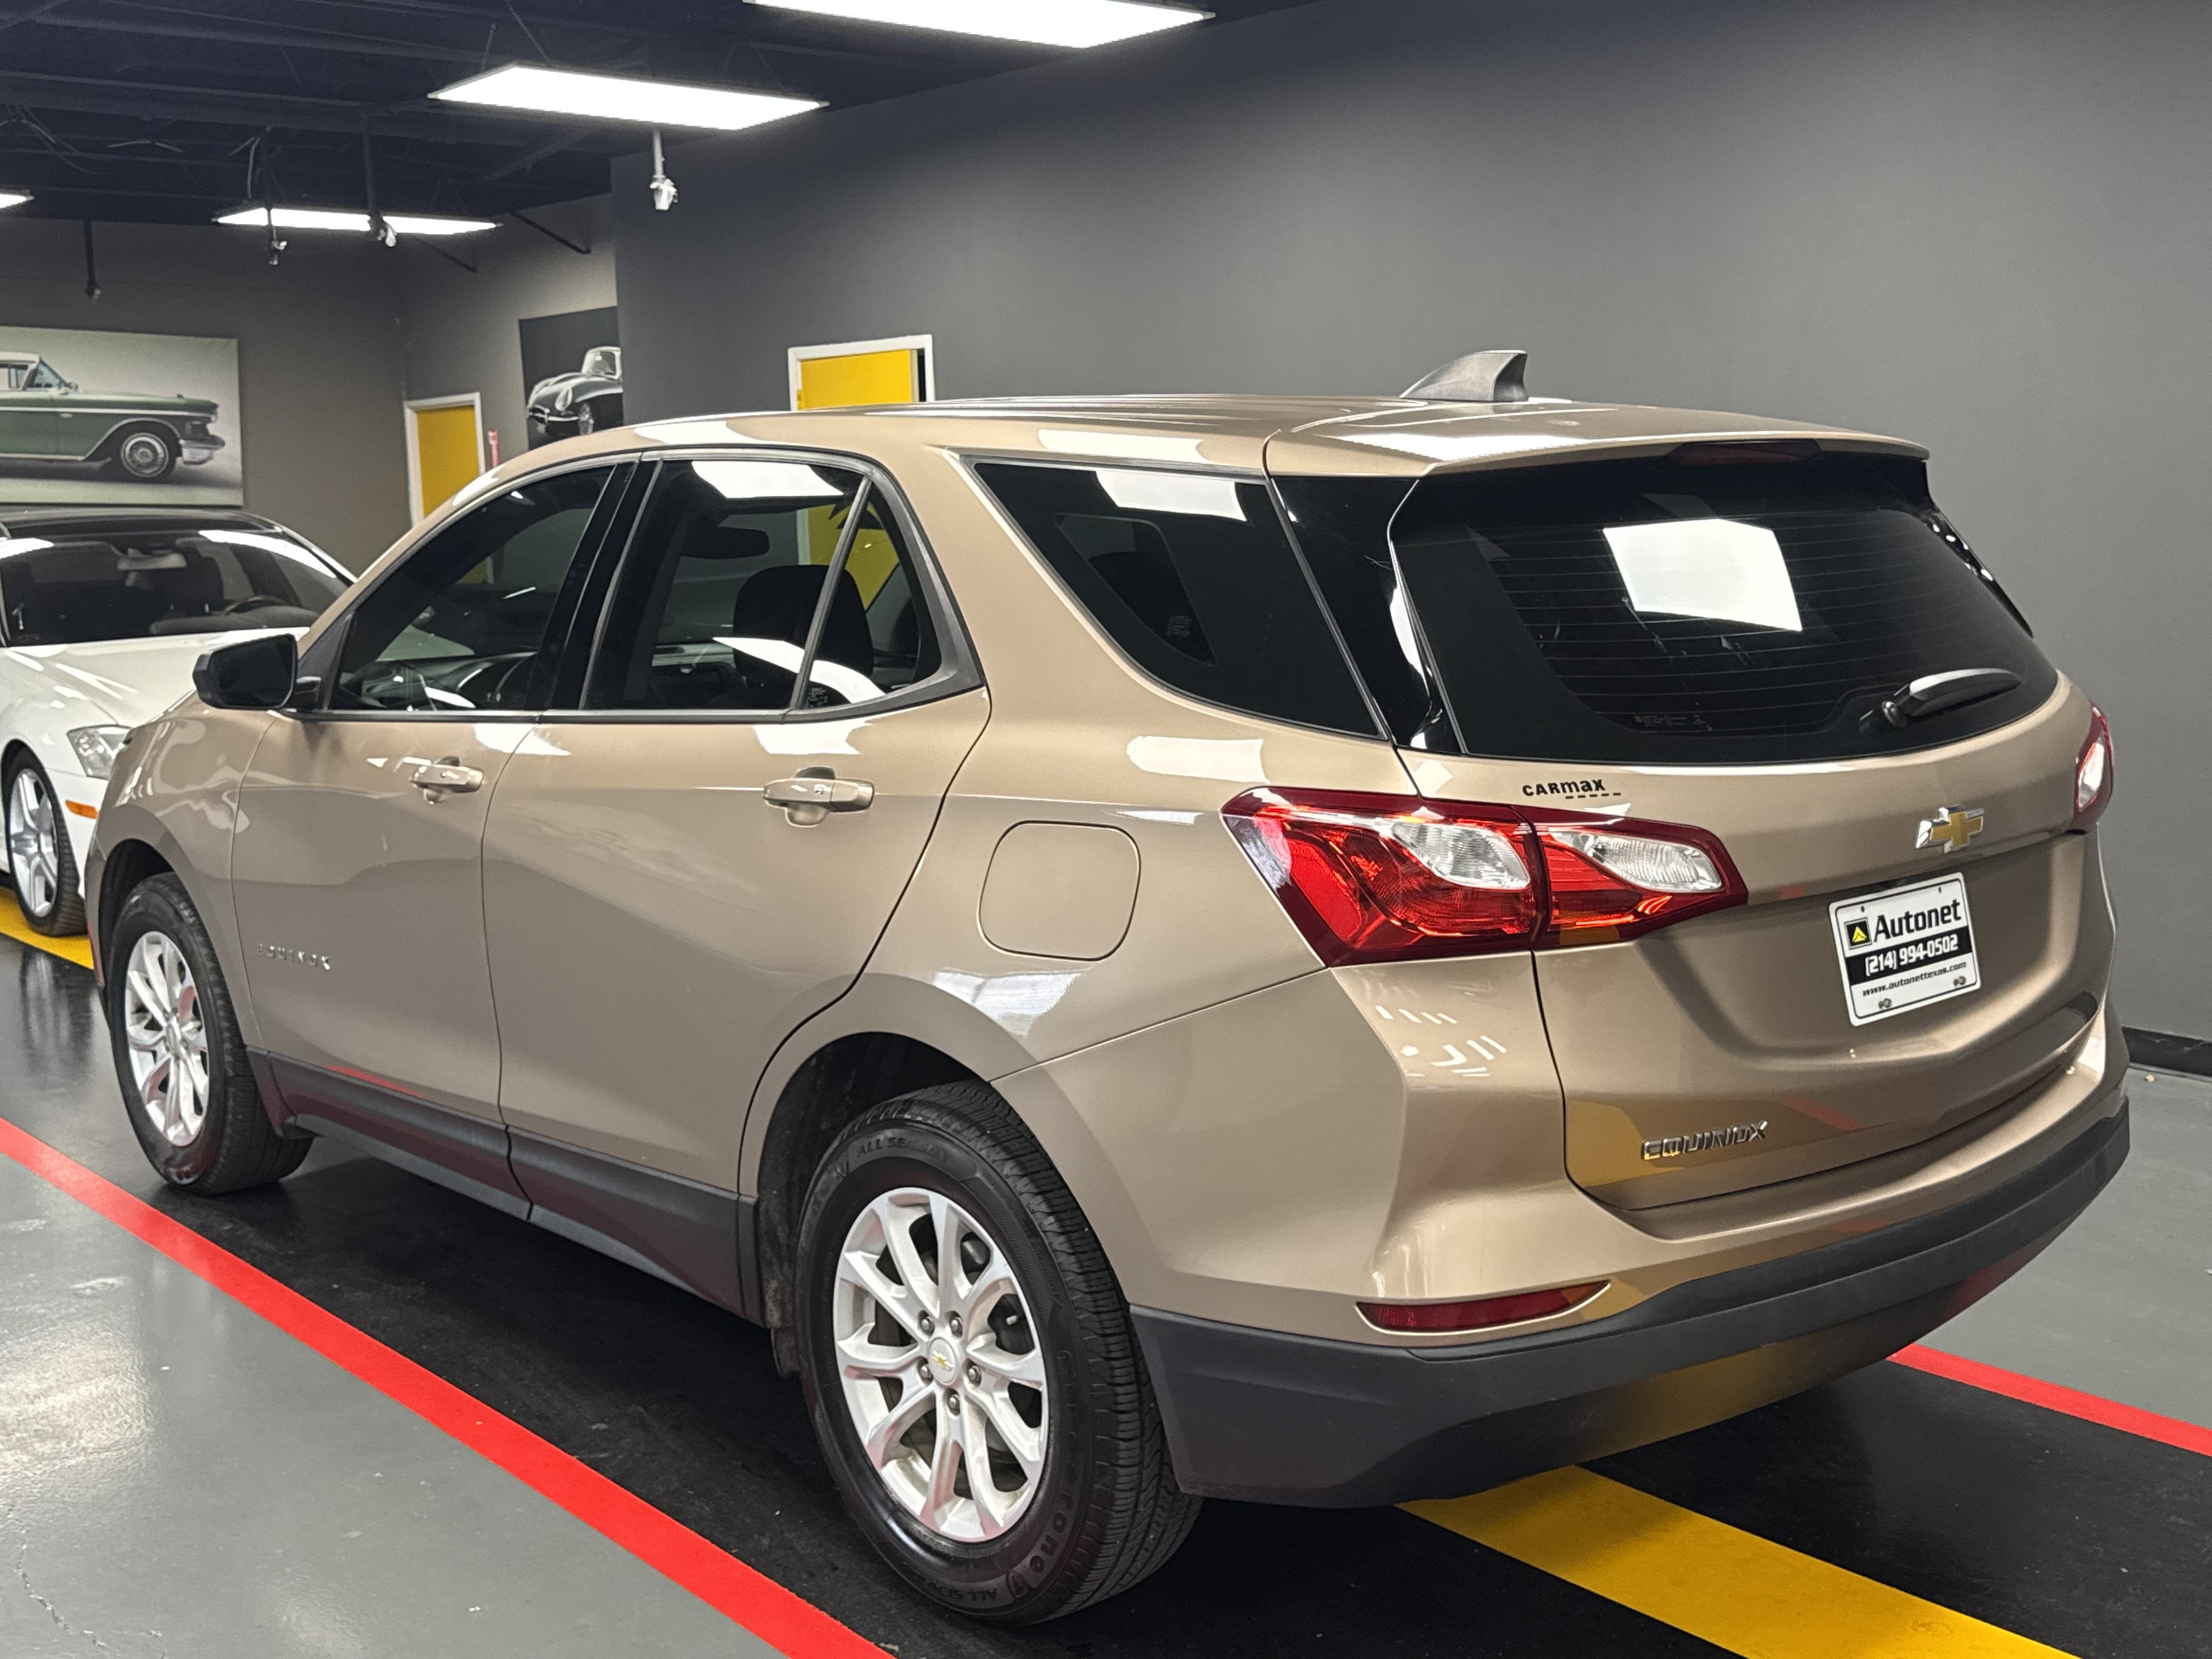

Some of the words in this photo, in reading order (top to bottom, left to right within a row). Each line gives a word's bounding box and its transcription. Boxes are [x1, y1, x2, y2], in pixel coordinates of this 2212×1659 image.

[1522, 779, 1606, 797] CARmax
[1873, 899, 1962, 943] Autonet
[1865, 950, 1898, 977] (214)
[1899, 933, 1959, 967] 994-0502
[1862, 961, 1967, 997] www.autonettexas.com
[857, 1138, 883, 1158] ALL
[1641, 1119, 1768, 1160] EQUINOX
